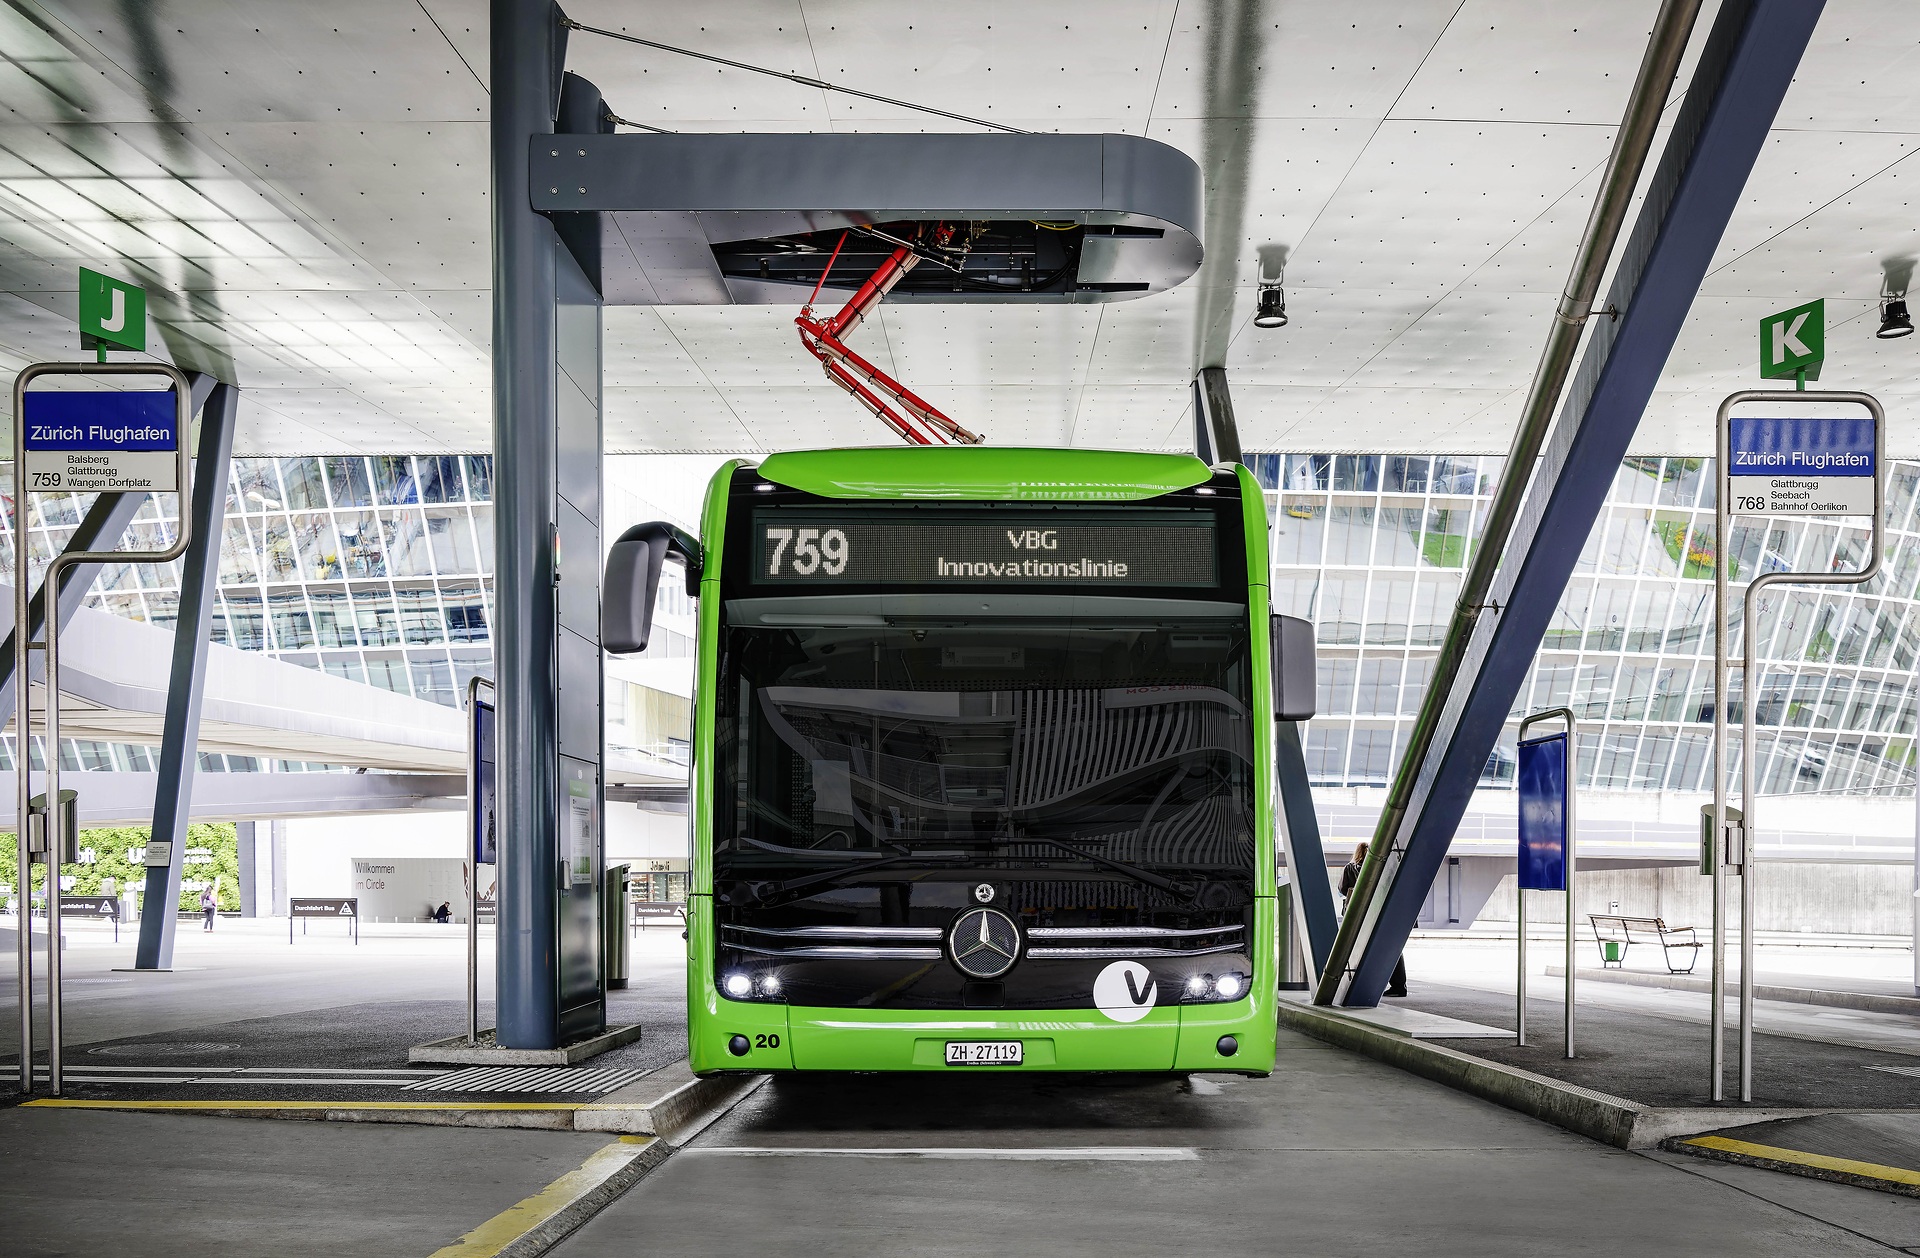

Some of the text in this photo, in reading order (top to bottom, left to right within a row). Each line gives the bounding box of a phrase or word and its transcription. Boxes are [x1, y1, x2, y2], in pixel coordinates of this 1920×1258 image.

[100, 287, 126, 333] J
[1772, 311, 1813, 366] K
[30, 425, 170, 444] Zürich Flughafen
[67, 455, 109, 465] Balsberg
[1736, 451, 1869, 470] Zürich Flughafen
[67, 466, 118, 477] Glattbrugg
[32, 473, 61, 487] 759
[67, 478, 151, 489] Wangen Dorfplatz
[1770, 479, 1819, 490] Glattbrugg
[1770, 491, 1810, 500] Seebach
[1737, 497, 1765, 510] 768
[1771, 502, 1848, 511] Bahnhof Oerlikon
[1007, 530, 1058, 550] VBG
[766, 528, 849, 576] 759
[937, 556, 1128, 578] Innovationslinie
[355, 862, 395, 874] Willkommen
[365, 878, 385, 890] Circle
[755, 1034, 780, 1049] 20
